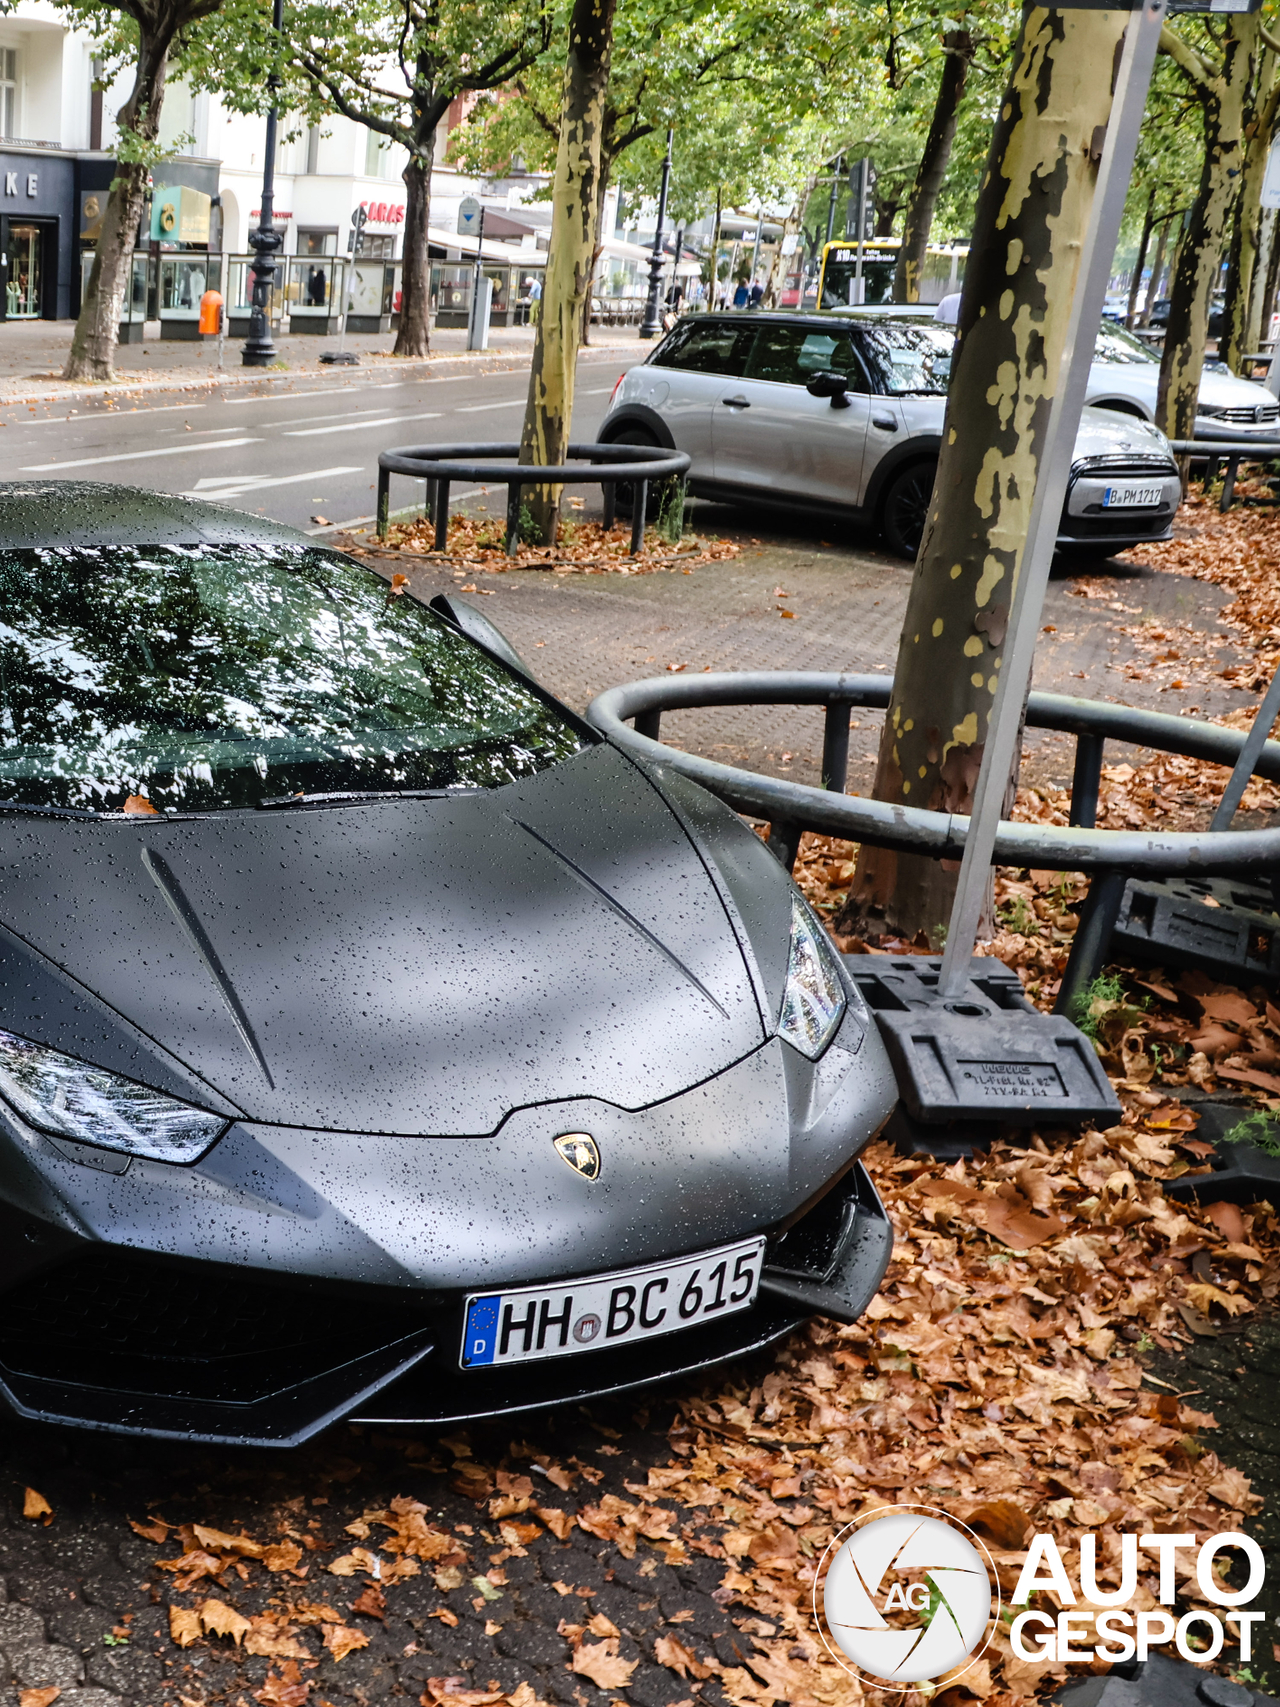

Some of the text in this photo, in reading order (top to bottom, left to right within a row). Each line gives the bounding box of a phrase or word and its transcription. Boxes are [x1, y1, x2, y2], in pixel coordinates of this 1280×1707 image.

[1110, 488, 1162, 504] B PM 1717
[473, 1250, 759, 1356] D HH BC 615
